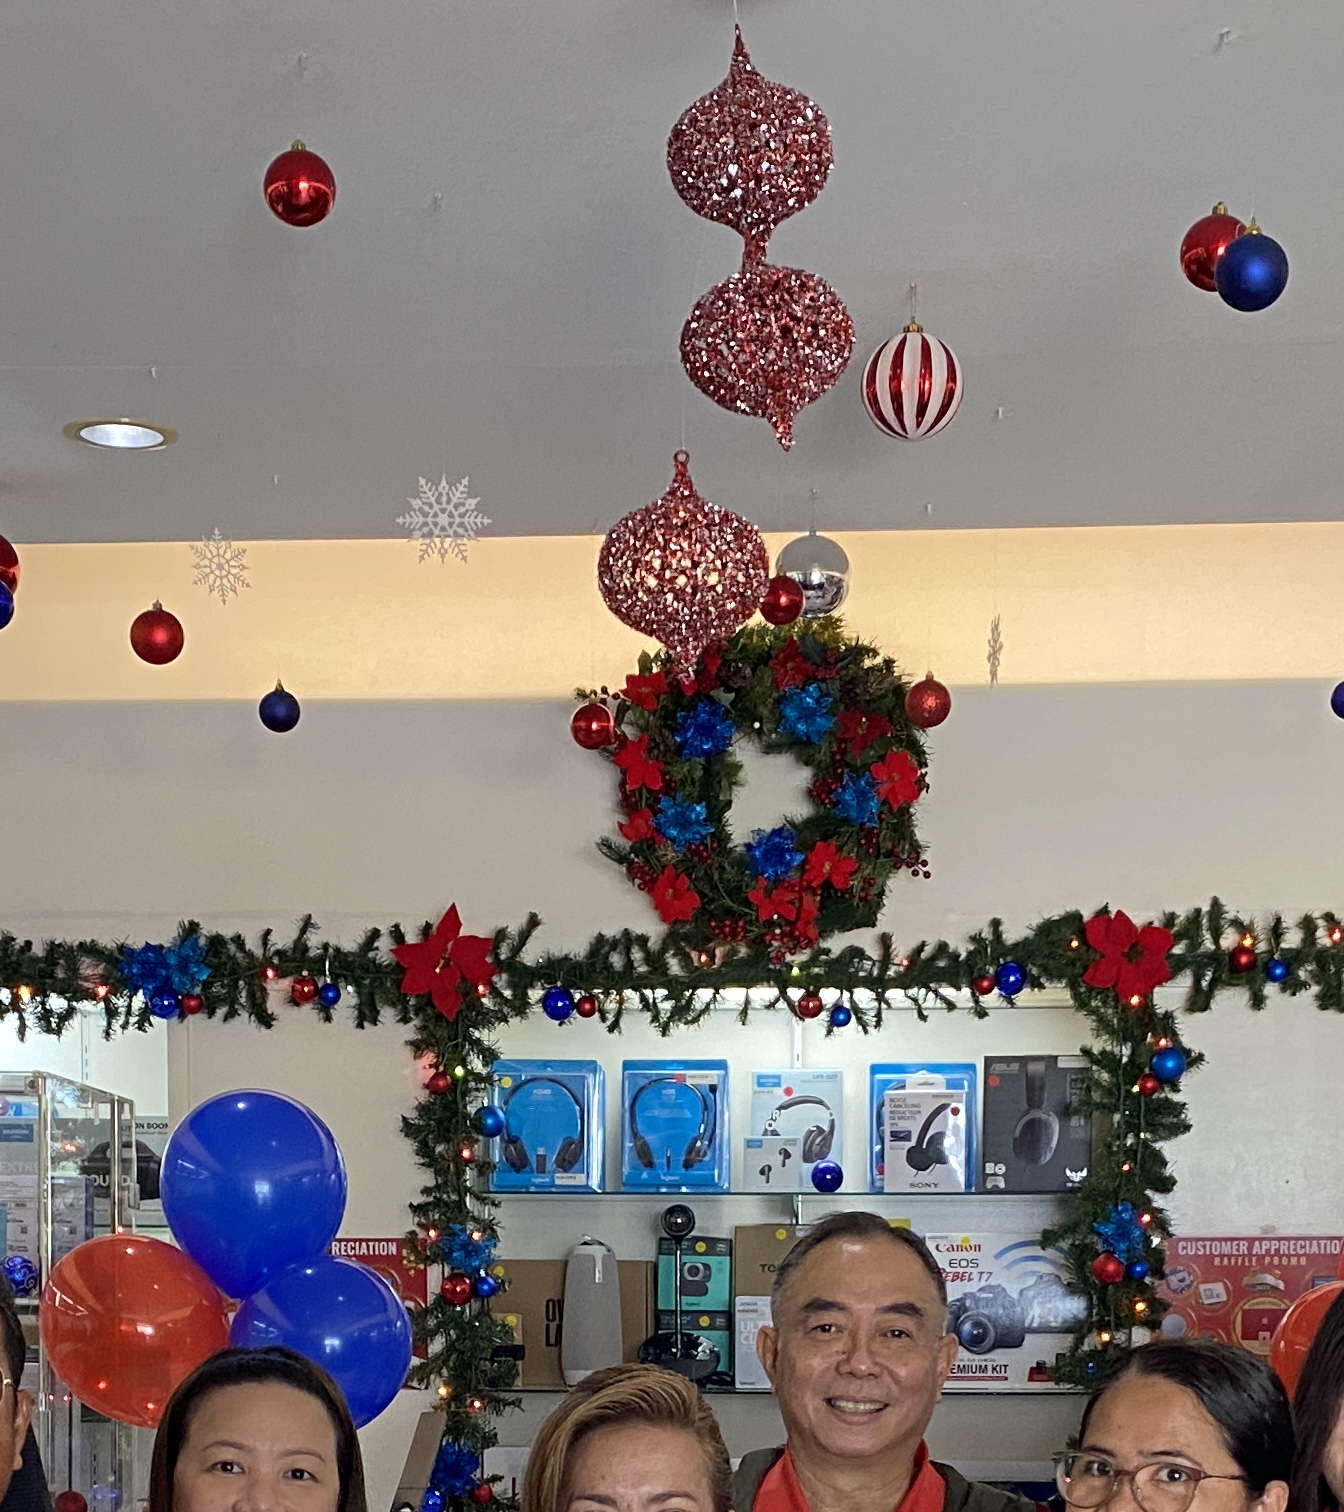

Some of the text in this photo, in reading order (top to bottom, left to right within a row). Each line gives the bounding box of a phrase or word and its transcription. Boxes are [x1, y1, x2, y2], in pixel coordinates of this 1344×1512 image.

[331, 1241, 397, 1255] RECIATION
[935, 1244, 982, 1253] Canon
[1178, 1240, 1342, 1255] CUSTOMER APPRECIATIO
[948, 1259, 979, 1268] EOS
[1214, 1257, 1307, 1266] RAFFLE PROMO
[977, 1272, 993, 1282] T7
[950, 1364, 1009, 1374] EMIUM KIT
